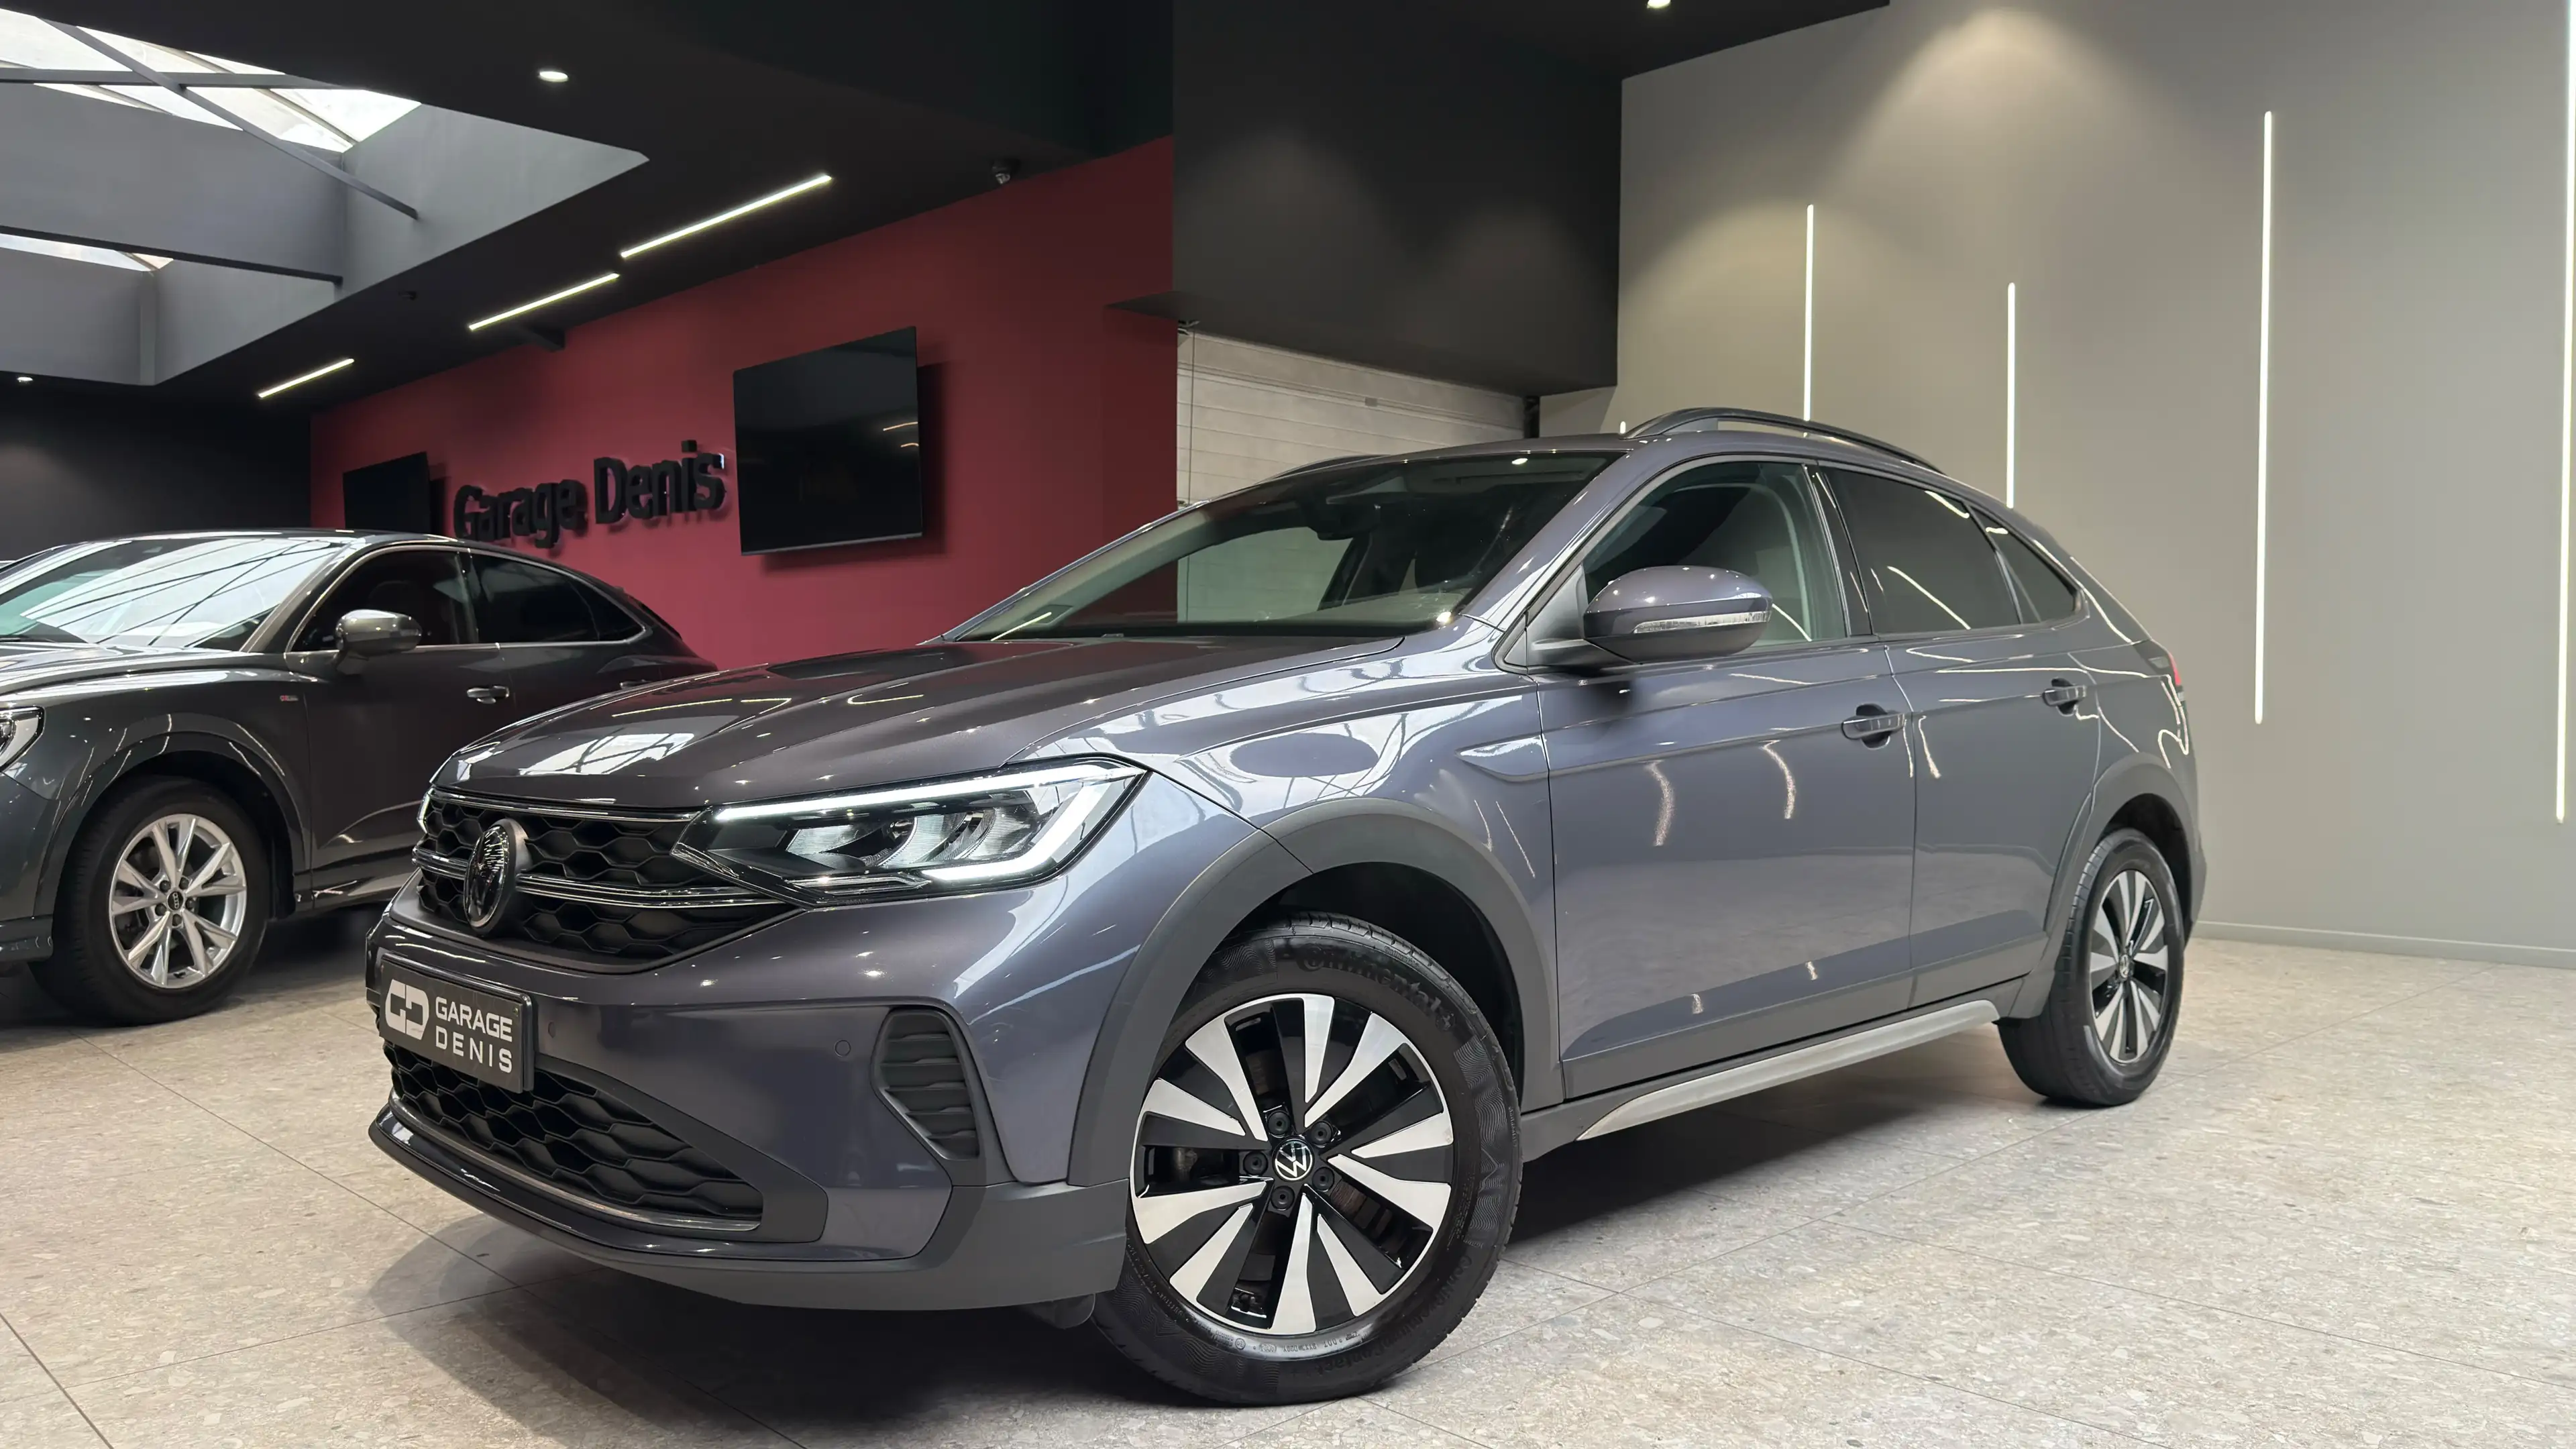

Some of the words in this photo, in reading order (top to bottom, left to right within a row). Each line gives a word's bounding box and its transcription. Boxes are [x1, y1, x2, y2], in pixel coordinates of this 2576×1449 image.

[453, 479, 589, 549] Garage
[593, 440, 727, 525] Denis
[435, 996, 513, 1042] GARAGE
[435, 1025, 513, 1074] DENIS
